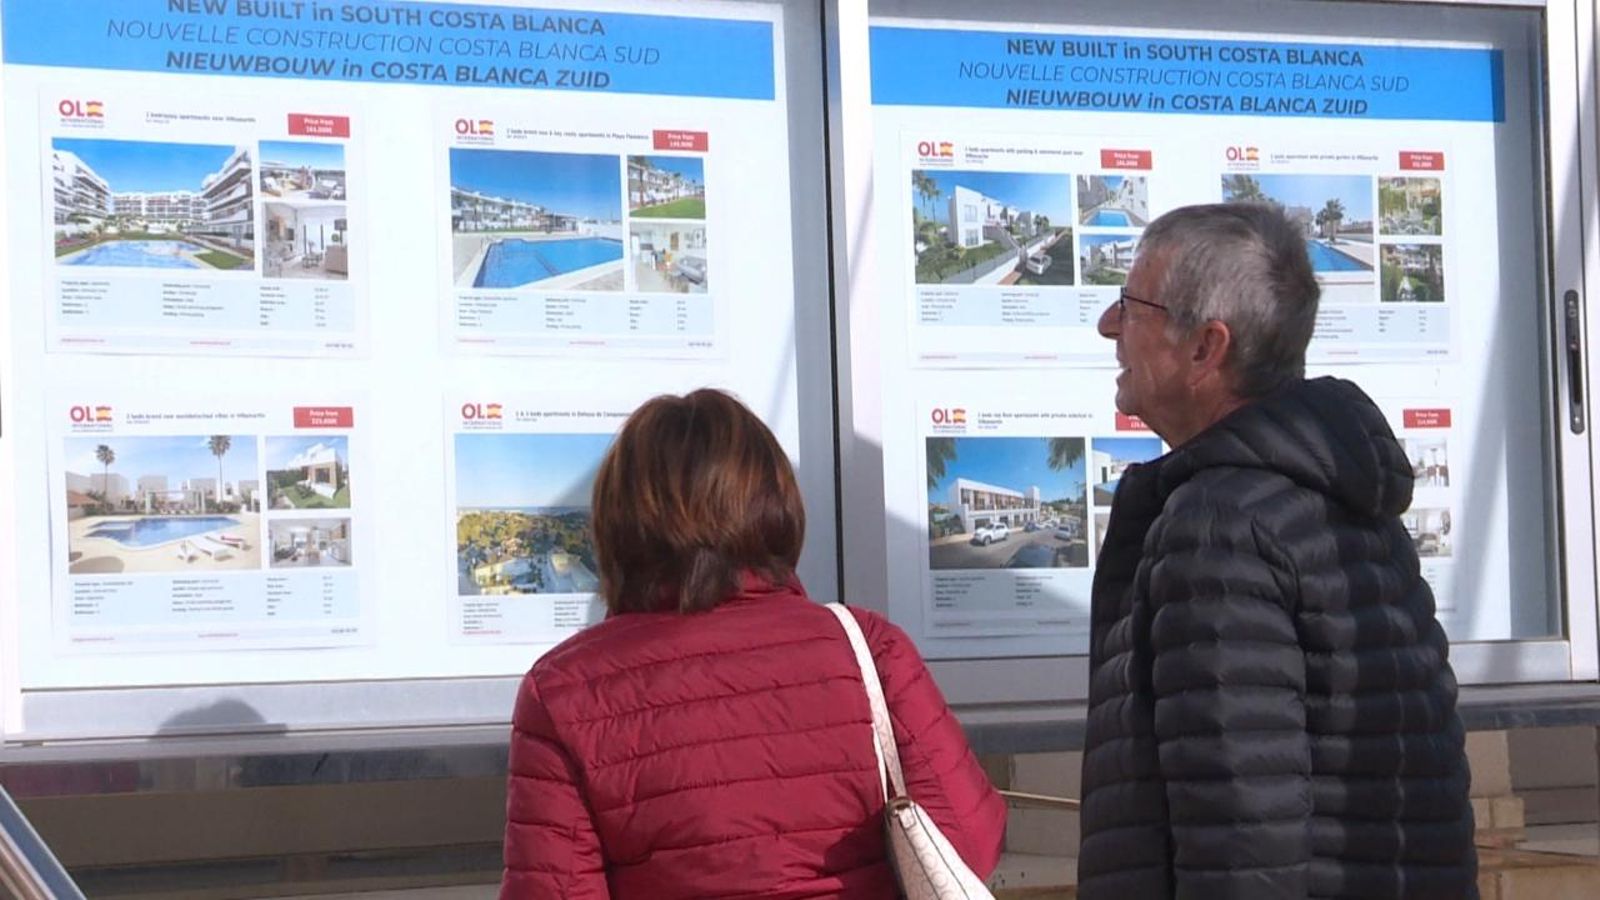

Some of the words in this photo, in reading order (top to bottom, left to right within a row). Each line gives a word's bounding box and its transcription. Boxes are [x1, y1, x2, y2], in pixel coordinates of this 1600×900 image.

[168, 0, 225, 15] NEW
[236, 0, 303, 20] BUILT
[314, 3, 333, 22] in
[341, 6, 422, 26] SOUTH
[429, 10, 505, 31] COSTA
[513, 14, 605, 36] BLANCA
[107, 19, 240, 44] NOUVELLE
[246, 26, 432, 54] CONSTRUCTION
[439, 38, 511, 58] COSTA
[518, 41, 608, 62] BLANCA
[613, 46, 660, 66] SUD
[1007, 39, 1055, 56] NEW
[1062, 41, 1117, 59] BUILT
[1124, 42, 1140, 60] in
[1147, 44, 1212, 62] SOUTH
[1219, 46, 1281, 64] COSTA
[1287, 49, 1364, 66] BLANCA
[166, 51, 334, 76] NIEUWBOUW
[342, 58, 362, 78] in
[371, 61, 448, 82] COSTA
[455, 65, 548, 87] BLANCA
[556, 70, 610, 88] ZUID
[959, 61, 1065, 82] NOUVELLE
[1070, 66, 1221, 86] CONSTRUCTION
[1226, 71, 1286, 88] COSTA
[1292, 73, 1365, 91] BLANCA
[1370, 76, 1410, 92] SUD
[1006, 88, 1142, 109] NIEUWBOUW
[1147, 93, 1165, 110] in
[1172, 94, 1234, 111] COSTA
[1240, 96, 1317, 114] BLANCA
[1322, 98, 1368, 114] ZUID
